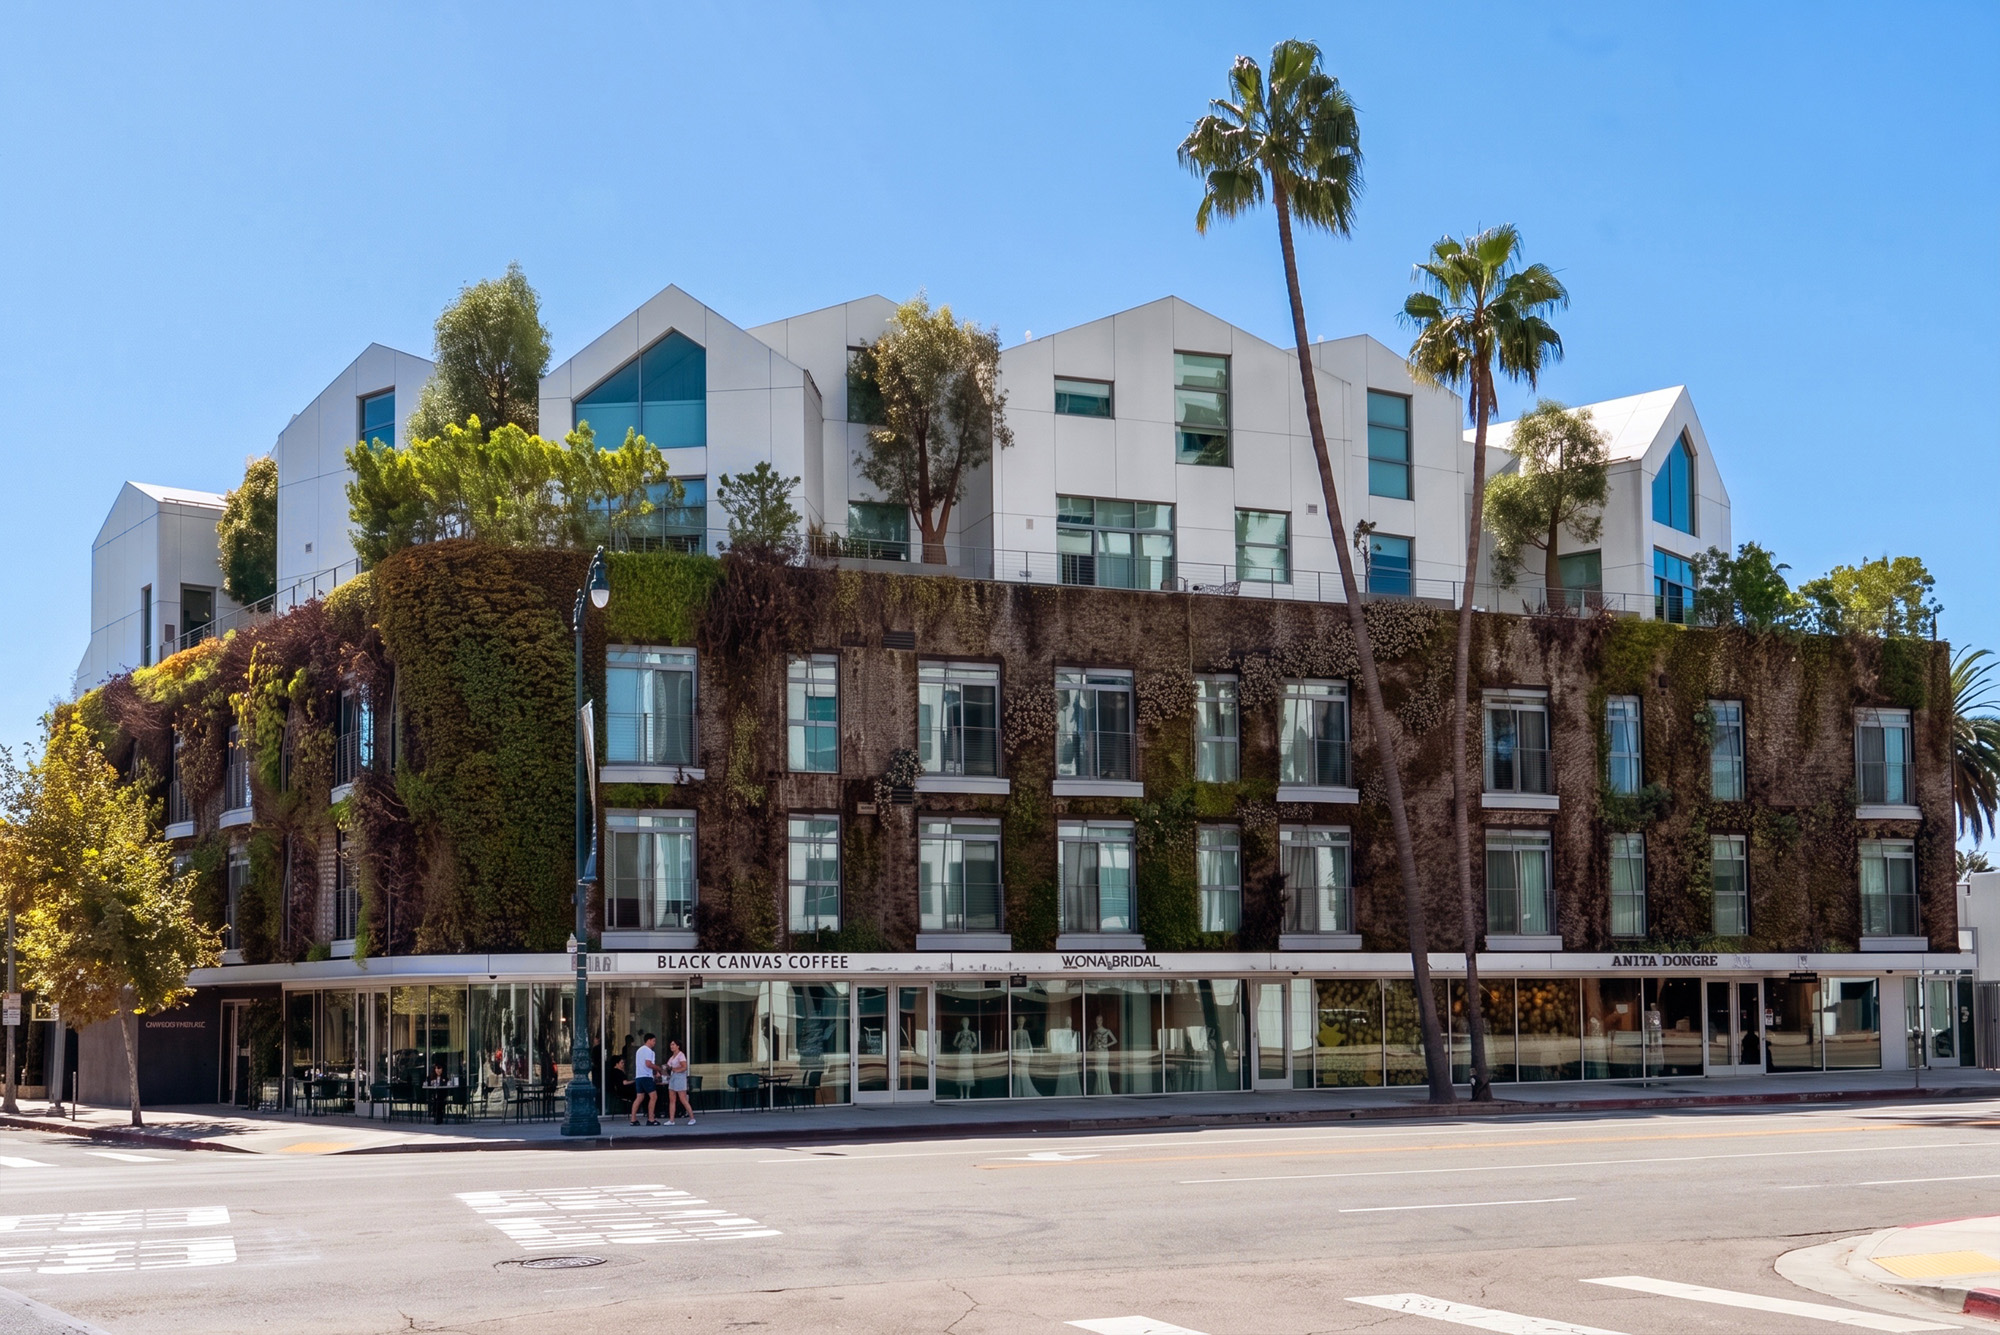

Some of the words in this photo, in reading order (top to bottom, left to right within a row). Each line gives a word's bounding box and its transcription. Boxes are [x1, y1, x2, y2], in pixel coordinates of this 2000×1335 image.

[657, 955, 711, 969] BLACK
[717, 955, 782, 969] CANVAS
[788, 955, 849, 969] COFFEE
[1061, 955, 1107, 968] WONA
[1112, 955, 1160, 968] BRIDAL
[1611, 955, 1658, 967] ANITA
[1662, 955, 1718, 967] DONGRE
